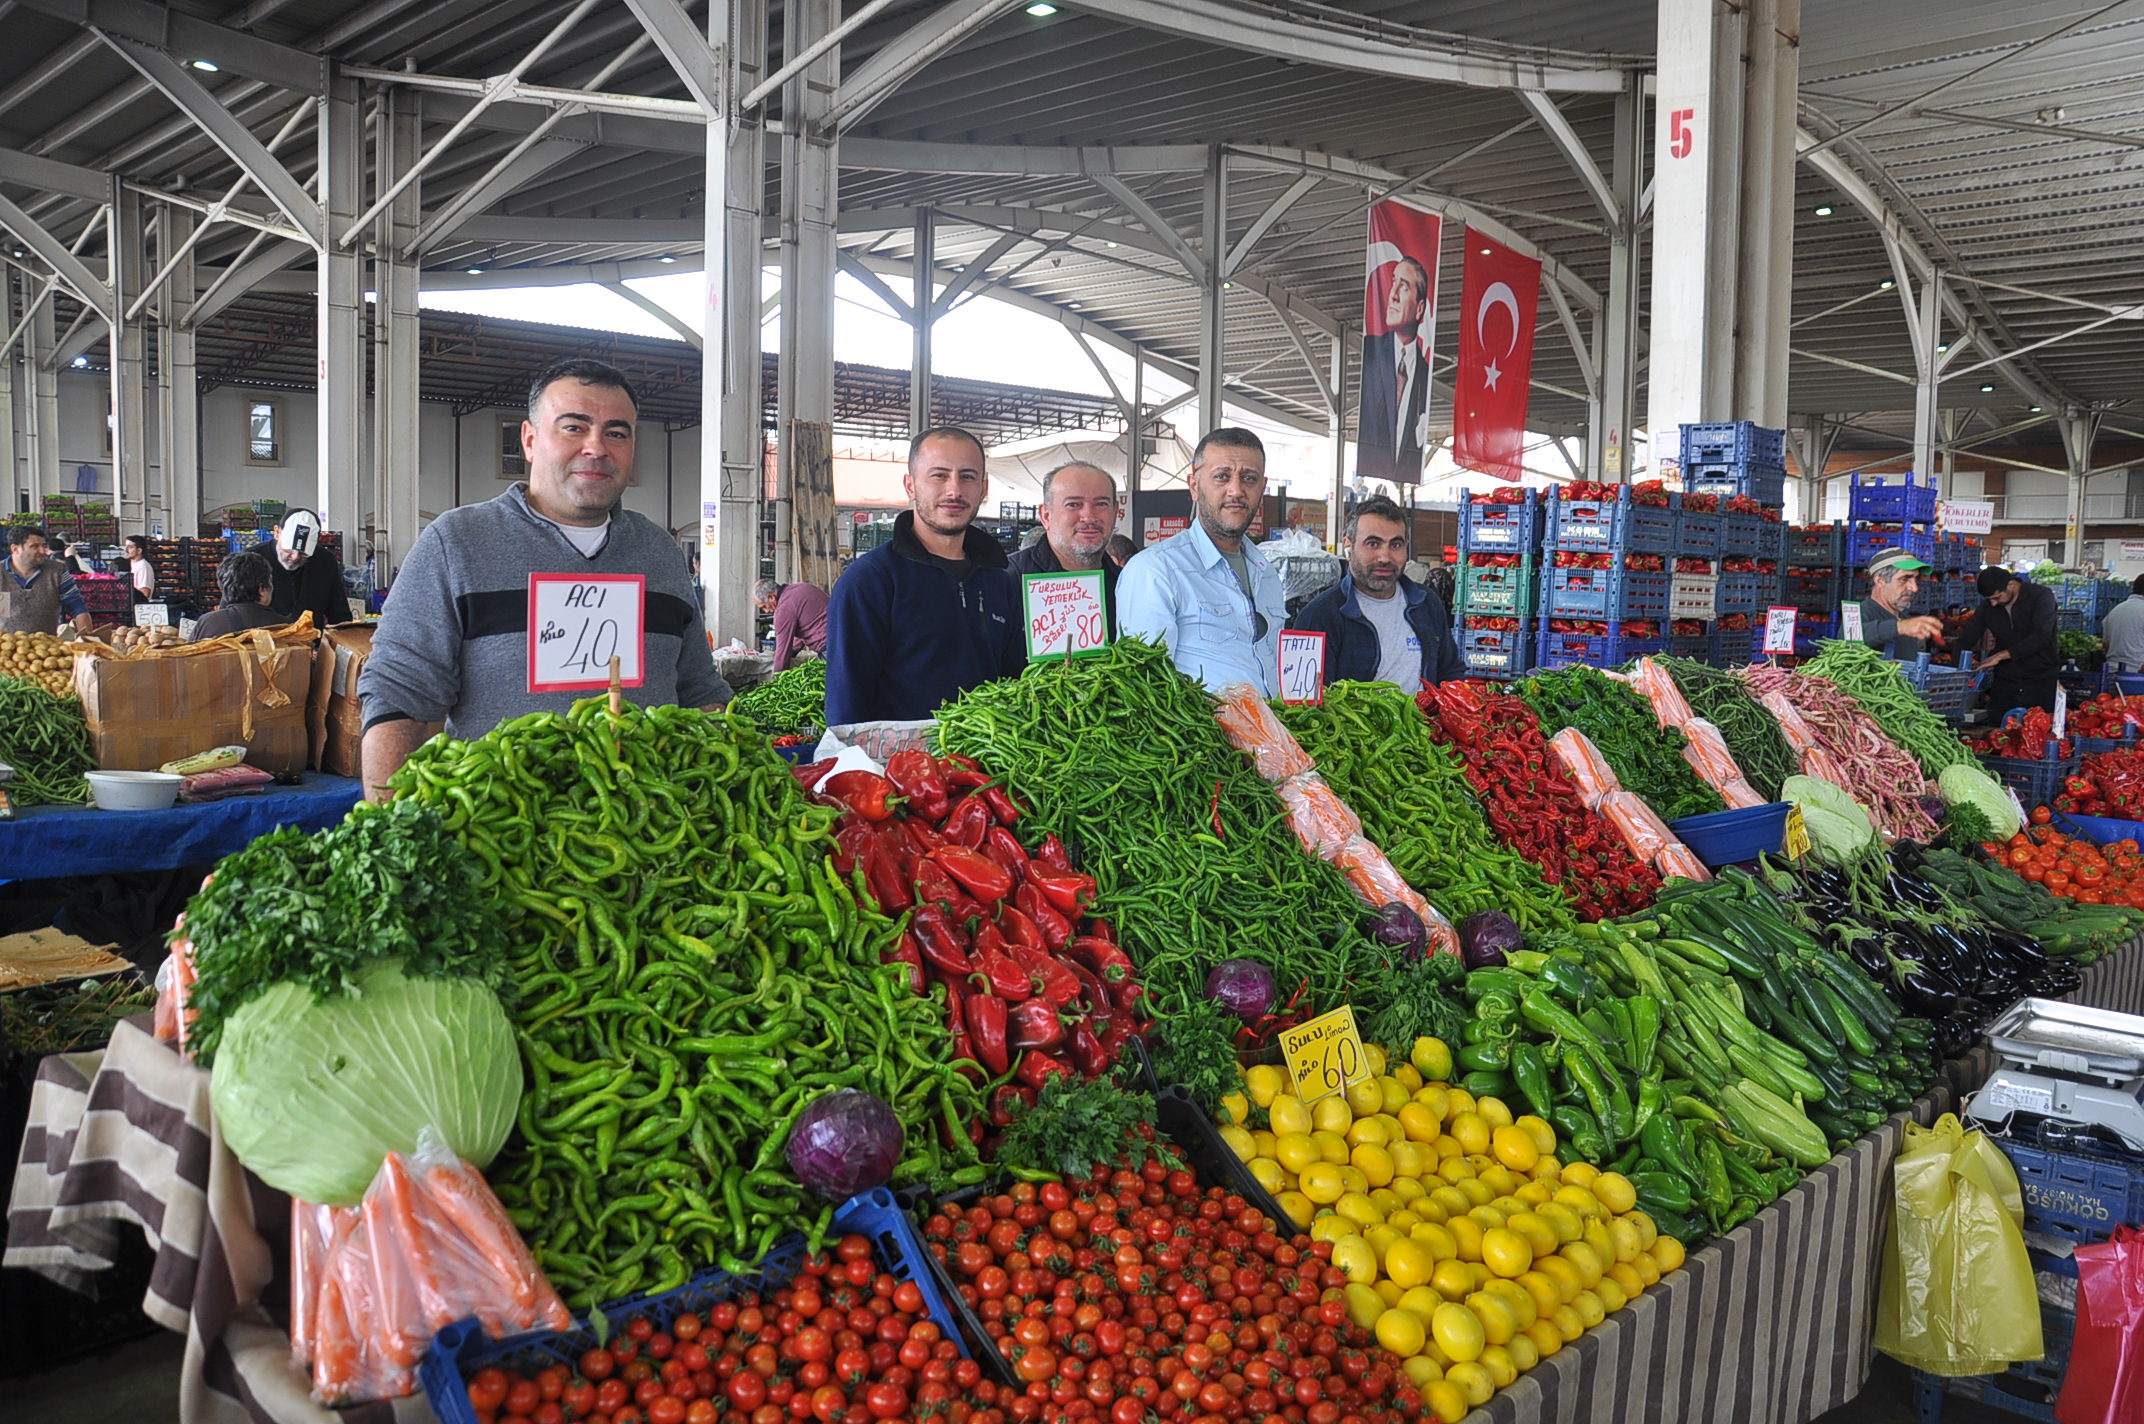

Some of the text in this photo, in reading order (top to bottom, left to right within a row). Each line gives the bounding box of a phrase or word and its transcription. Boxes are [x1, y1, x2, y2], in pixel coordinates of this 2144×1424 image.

[1670, 108, 1694, 159] 5
[564, 583, 607, 608] ACI
[1031, 608, 1057, 639] ACI
[1076, 612, 1104, 649] 80
[560, 616, 618, 674] 40
[1282, 638, 1316, 651] TATLI
[1291, 656, 1317, 697] 40
[1322, 1037, 1357, 1089] 60
